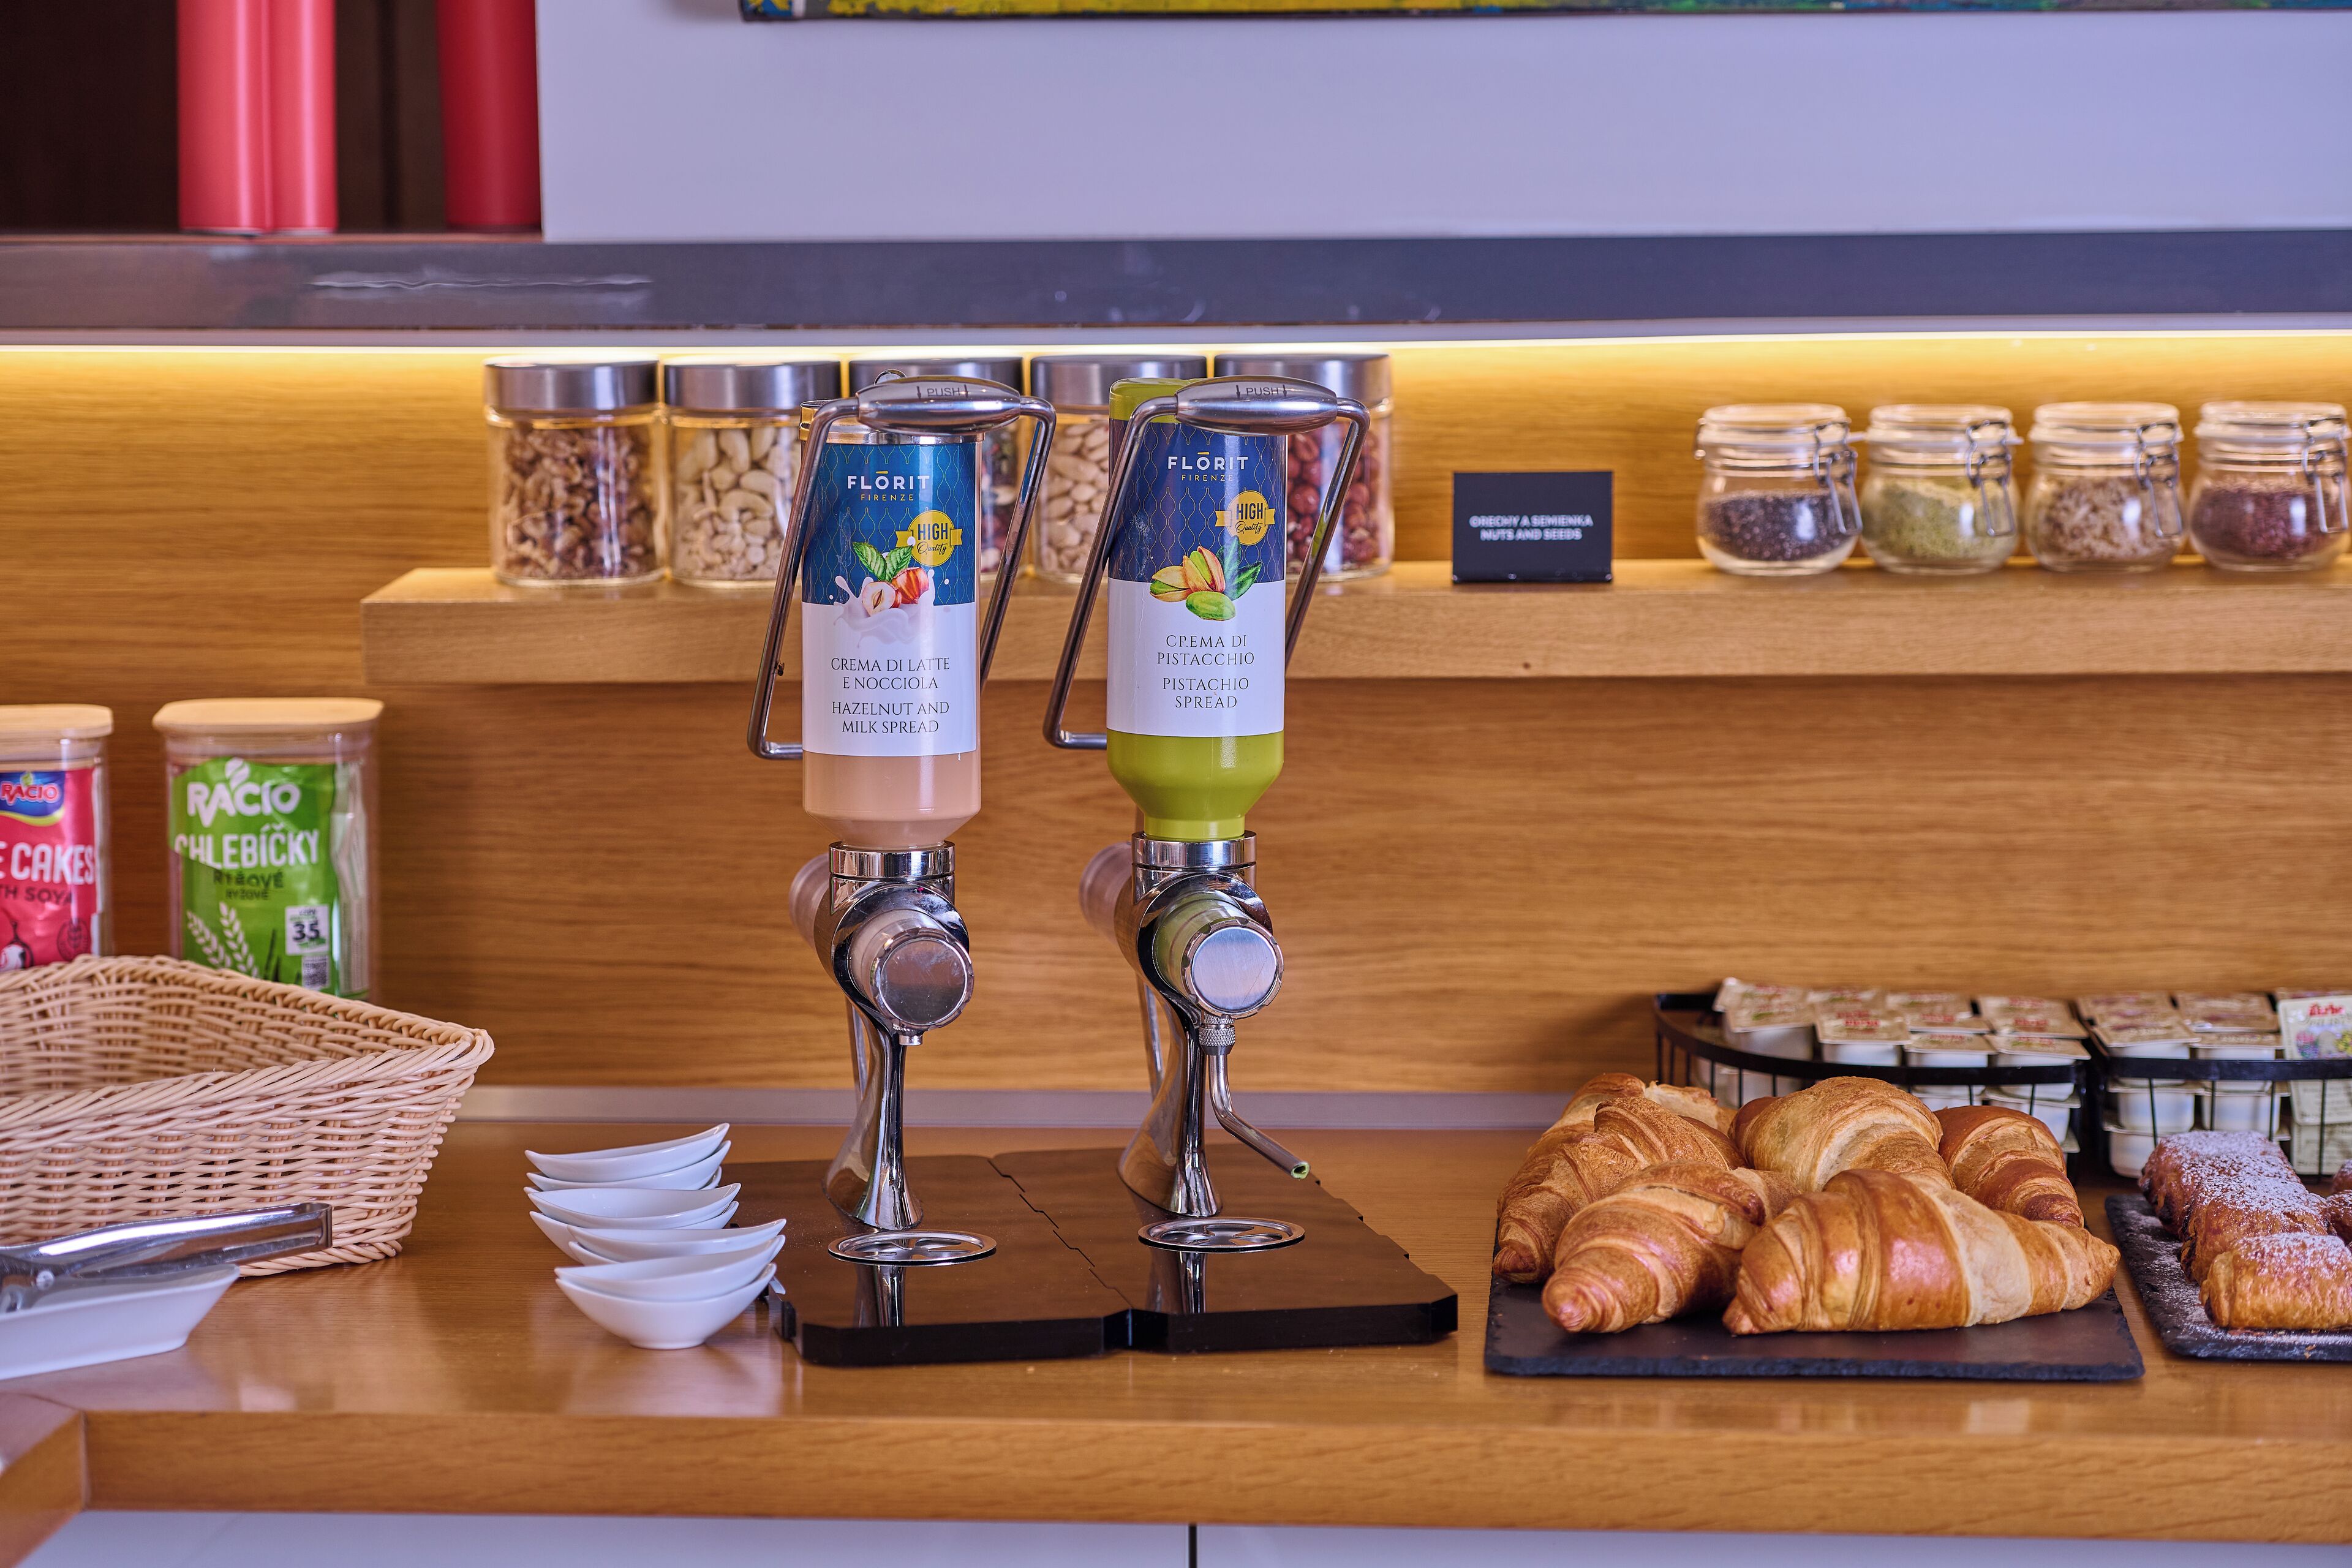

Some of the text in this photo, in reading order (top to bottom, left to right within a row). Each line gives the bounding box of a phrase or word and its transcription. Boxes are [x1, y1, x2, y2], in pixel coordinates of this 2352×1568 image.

[927, 387, 960, 397] PUSH
[1246, 386, 1279, 396] PUSH
[1236, 502, 1264, 520] HIGH
[1235, 521, 1263, 534] Quality
[1520, 515, 1531, 527] A
[918, 522, 948, 540] HIGH
[1480, 528, 1583, 541] NUTS AND SEEDS
[916, 541, 948, 555] Quality
[1166, 635, 1247, 648] CREMA DI
[831, 657, 950, 672] CREMA DI LATTE
[1157, 652, 1255, 666] PISTACCHIO
[843, 676, 938, 690] E NOCCIOLA
[1163, 677, 1250, 691] PISTACHIO
[832, 701, 949, 715] HAZELNUT AND
[1175, 695, 1237, 709] SPREAD
[842, 720, 939, 734] MILK SPREAD
[1, 782, 59, 806] RACIO
[186, 781, 301, 827] RACIO
[10, 842, 95, 885] CAKES
[293, 921, 320, 941] 35
